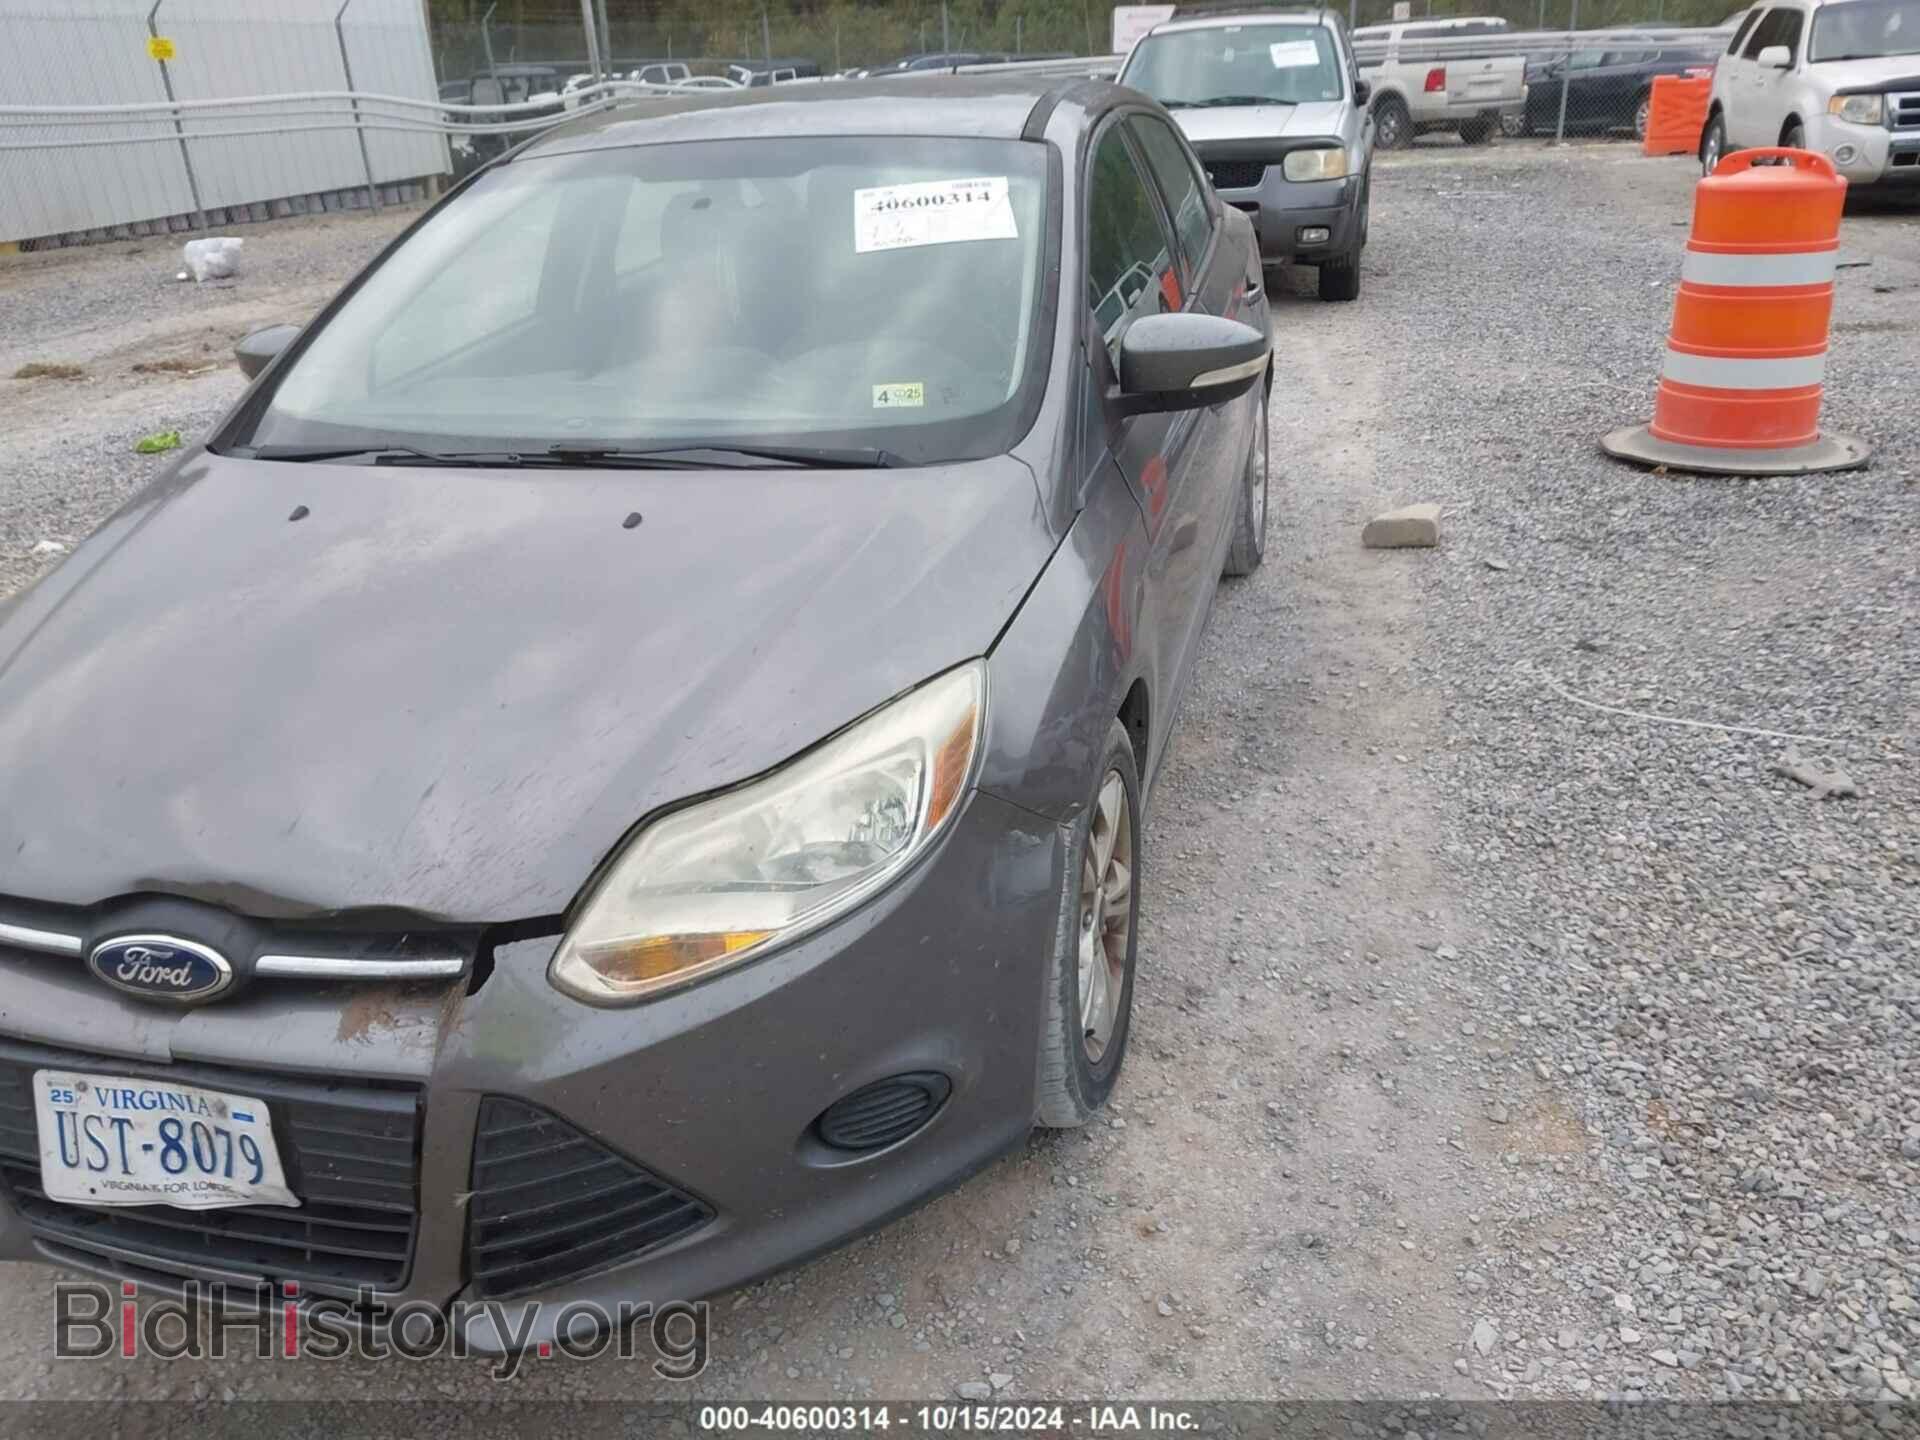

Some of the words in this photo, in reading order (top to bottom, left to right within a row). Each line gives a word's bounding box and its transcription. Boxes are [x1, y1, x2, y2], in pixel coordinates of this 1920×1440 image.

[871, 190, 990, 212] 40600314
[878, 390, 889, 404] 4
[906, 388, 921, 400] 25
[117, 946, 193, 987] Ford
[51, 1089, 73, 1103] 25
[94, 1086, 213, 1118] VIRGINIA
[55, 1110, 264, 1186] UST-8079
[164, 1181, 189, 1194] FOR
